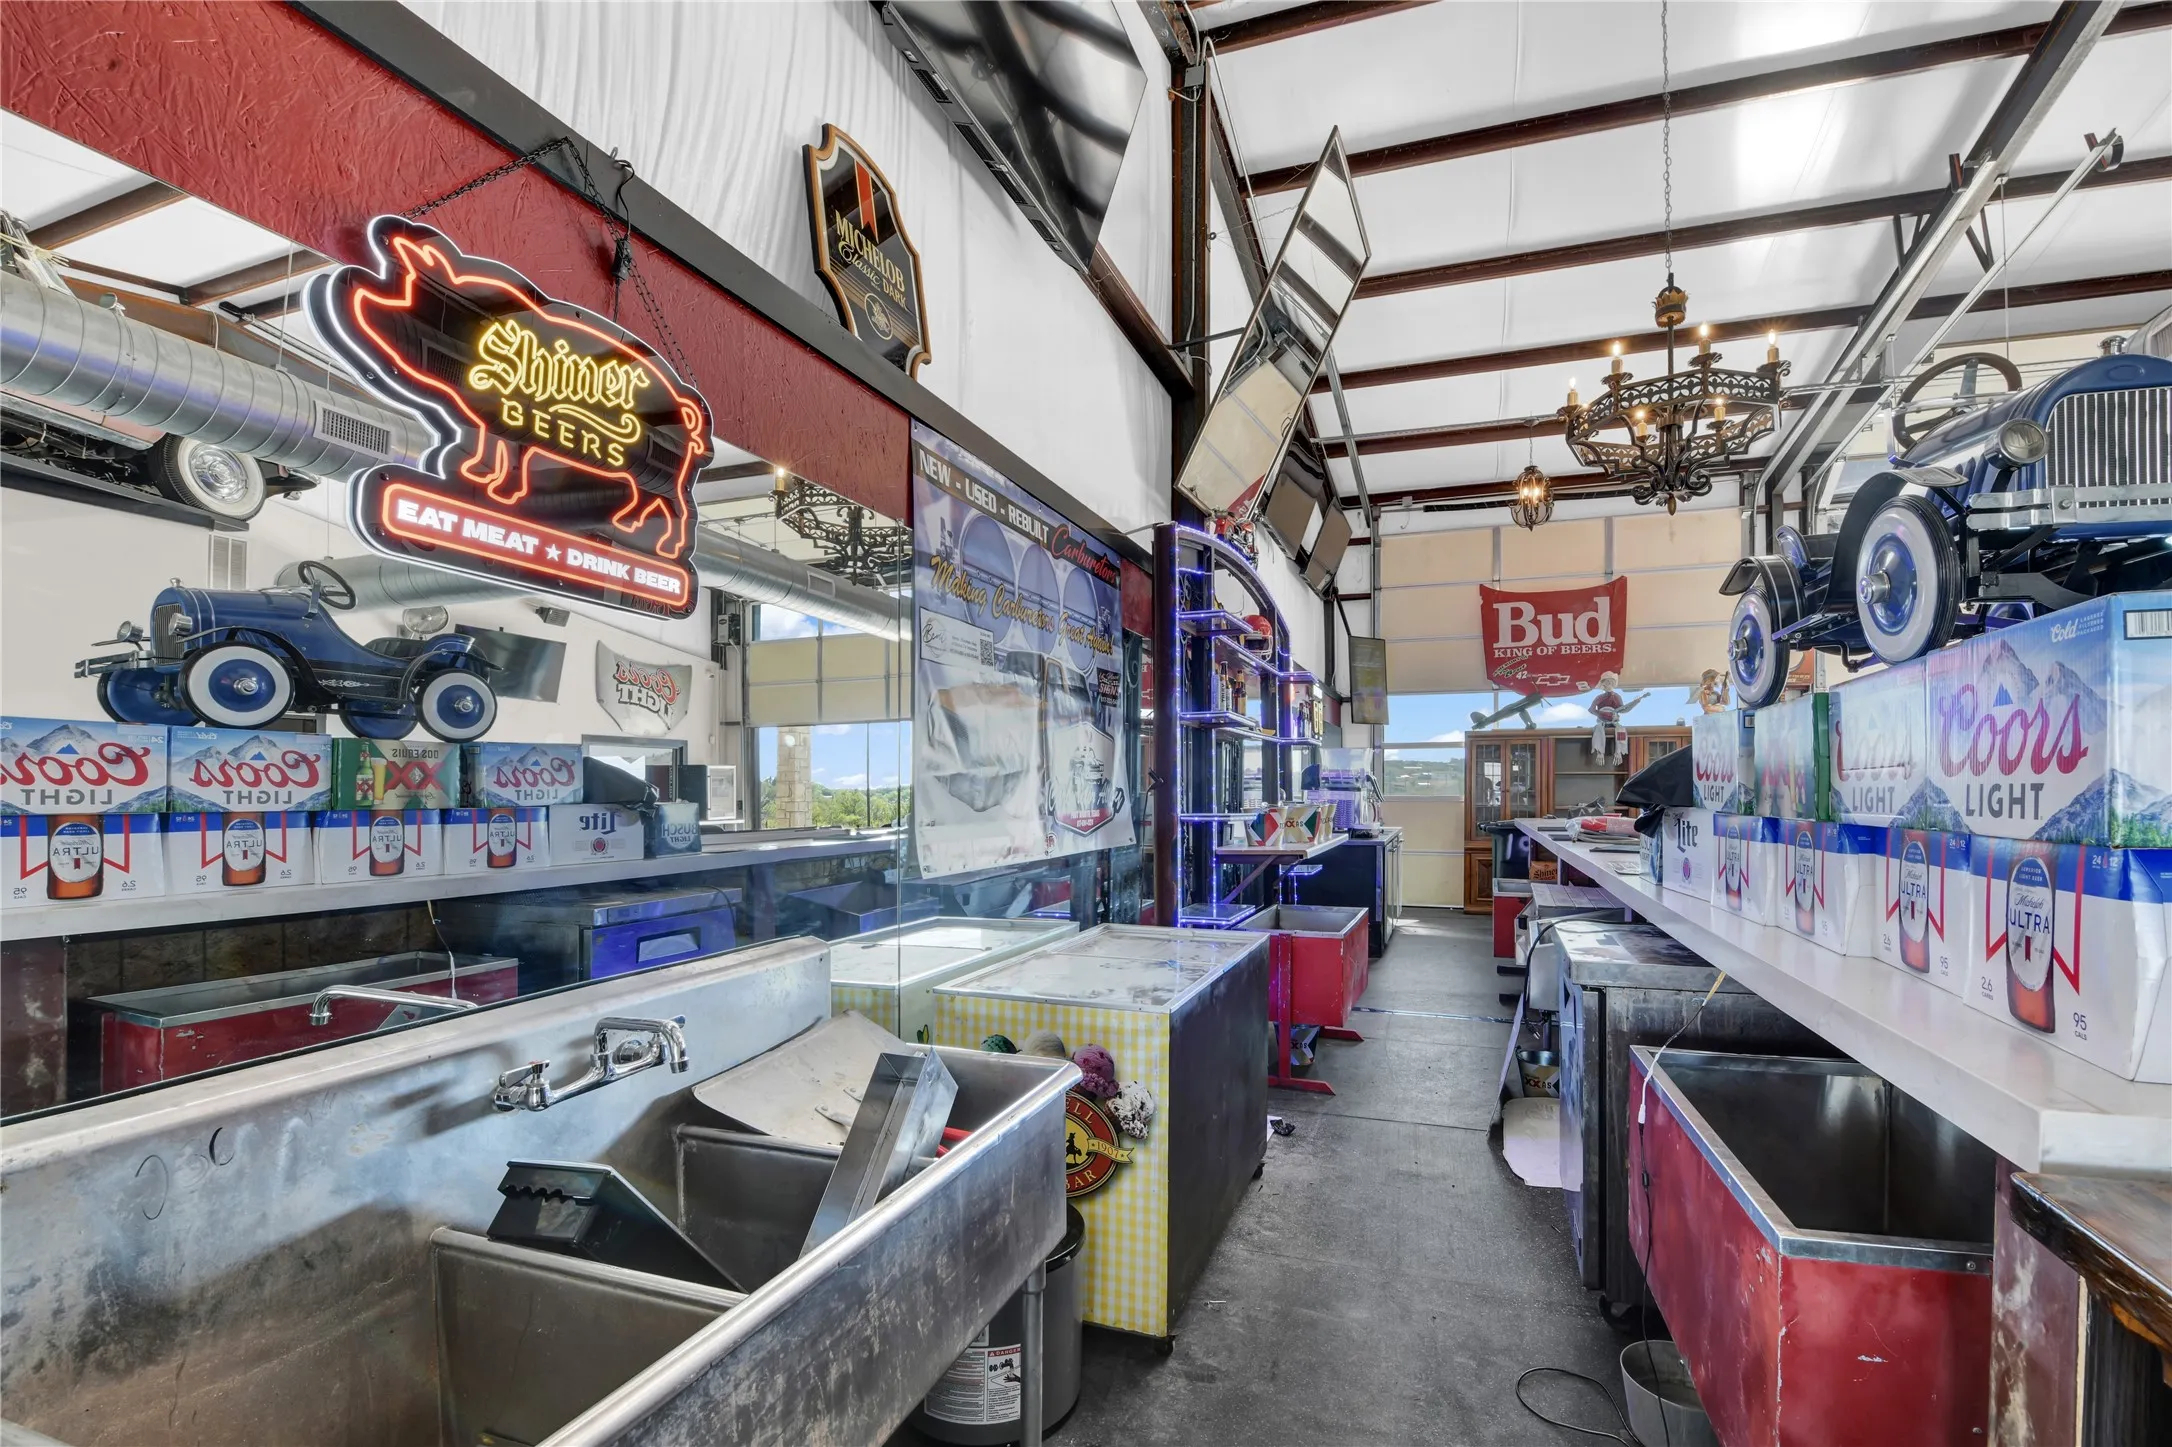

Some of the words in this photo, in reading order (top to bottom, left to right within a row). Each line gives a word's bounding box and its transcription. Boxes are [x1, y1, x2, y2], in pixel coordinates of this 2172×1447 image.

[835, 209, 907, 292] MICHELOB
[838, 240, 881, 286] Classic
[883, 278, 907, 311] DARK
[468, 318, 650, 411] Shiner
[501, 397, 624, 467] BEERS
[918, 448, 951, 488] NEW
[964, 477, 998, 515] USED
[1007, 504, 1050, 545] REBUILT
[397, 499, 459, 533] EAT
[463, 518, 539, 556] MEAT
[566, 550, 630, 581] DRINK
[633, 568, 681, 594] BEER
[1050, 522, 1117, 585] Carburetors
[930, 554, 987, 617] Making
[991, 583, 1055, 633] Carburetors
[1493, 596, 1615, 648] Bud
[2051, 618, 2078, 643] Cold
[1494, 647, 1533, 658] KING
[1536, 646, 1558, 656] OF
[1939, 683, 2089, 777] Coors
[1703, 784, 1725, 803] LIGHT
[1852, 786, 1896, 813] LIGHT
[1965, 782, 2045, 820] LIGHT
[1674, 818, 1698, 853] Lite
[1949, 838, 1956, 847] 24
[1960, 840, 1966, 848] 12
[2092, 855, 2101, 865] 24
[2109, 856, 2119, 867] 12
[1900, 881, 1927, 899] ULTRA
[2015, 893, 2045, 909] Michelob
[2009, 908, 2050, 935] ULTRA
[1939, 956, 1949, 969] 95
[1981, 976, 1993, 992] 2.6
[2073, 1012, 2087, 1031] 95
[2074, 1031, 2087, 1040] CALS
[1096, 1139, 1119, 1159] 1907
